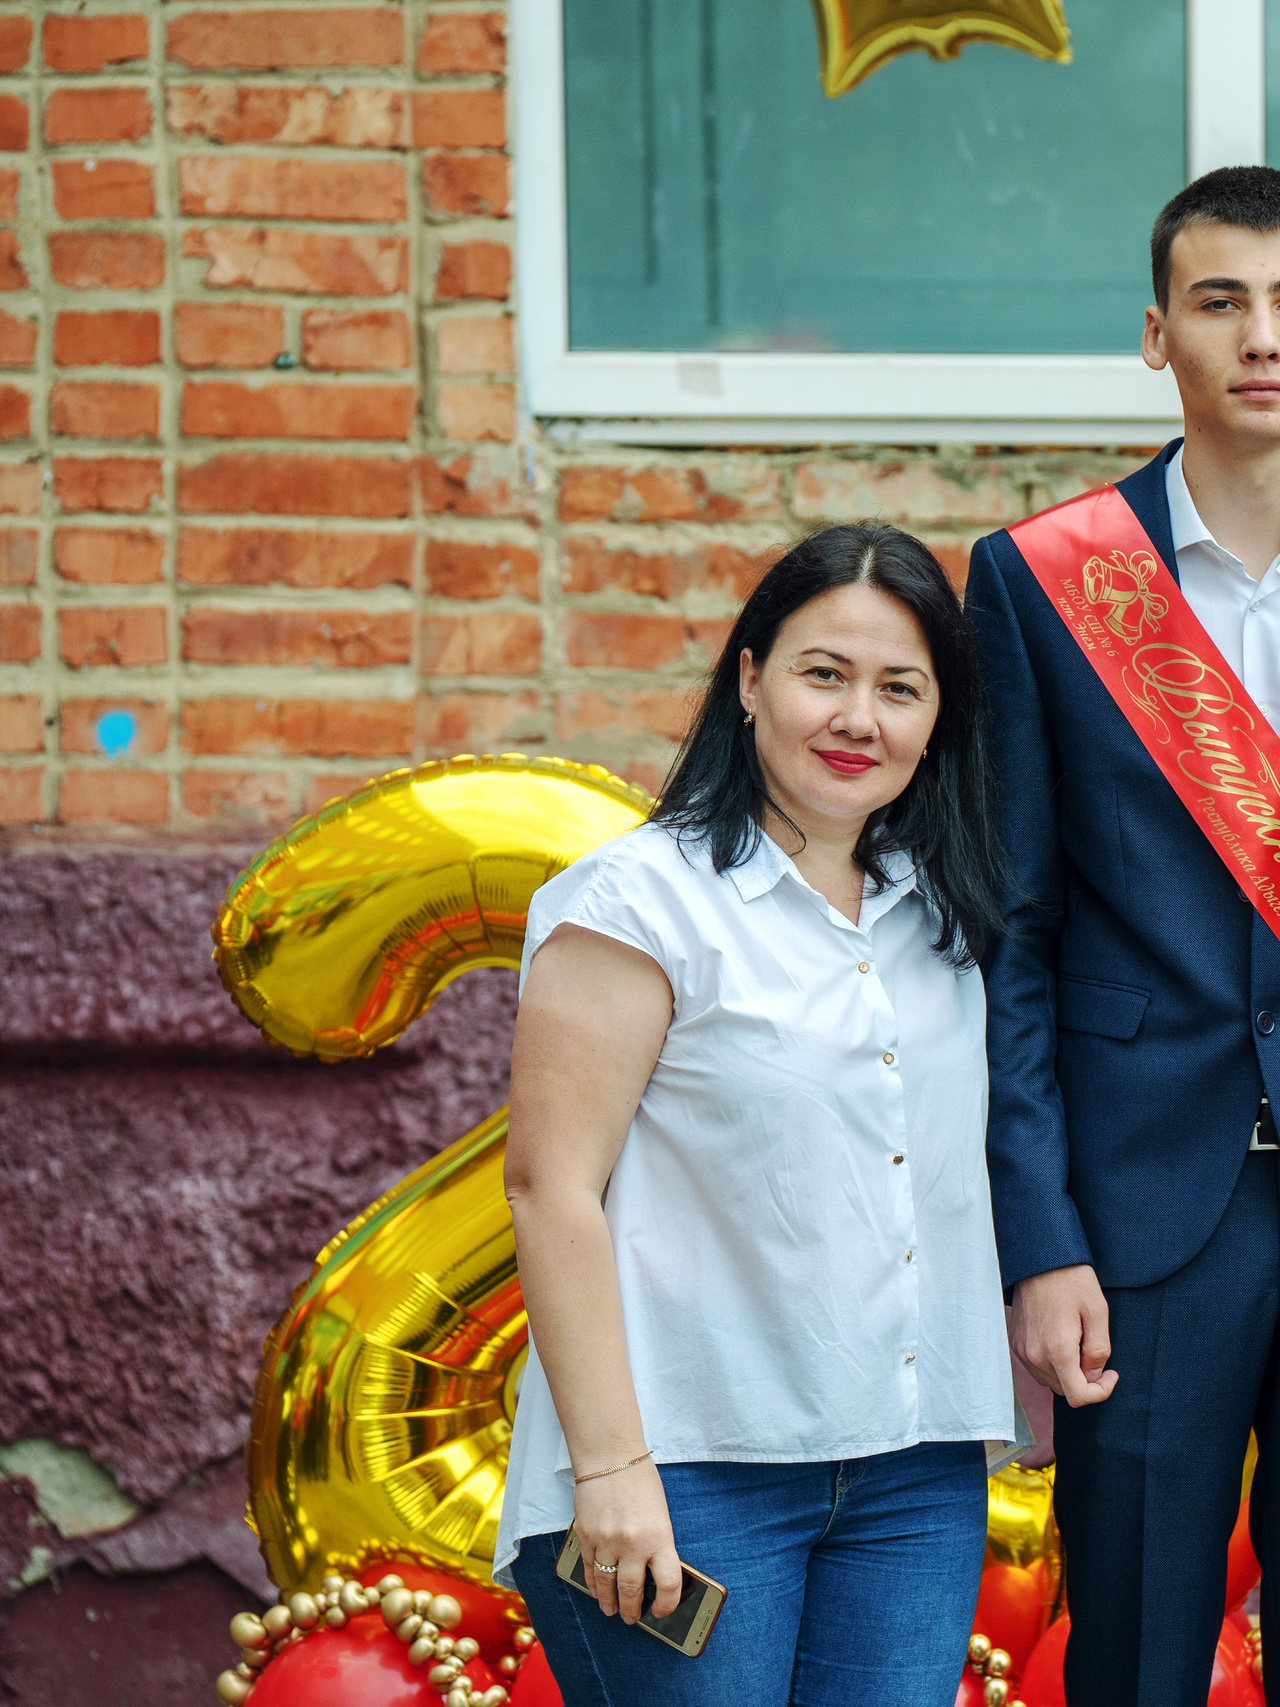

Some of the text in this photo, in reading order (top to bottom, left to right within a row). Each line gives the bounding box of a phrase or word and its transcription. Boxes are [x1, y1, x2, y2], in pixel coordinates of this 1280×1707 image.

[1056, 597, 1097, 651] пгт. Энем
[1060, 578, 1092, 612] МБОУ
[1084, 614, 1106, 635] СШ
[1197, 796, 1256, 873] Республика
